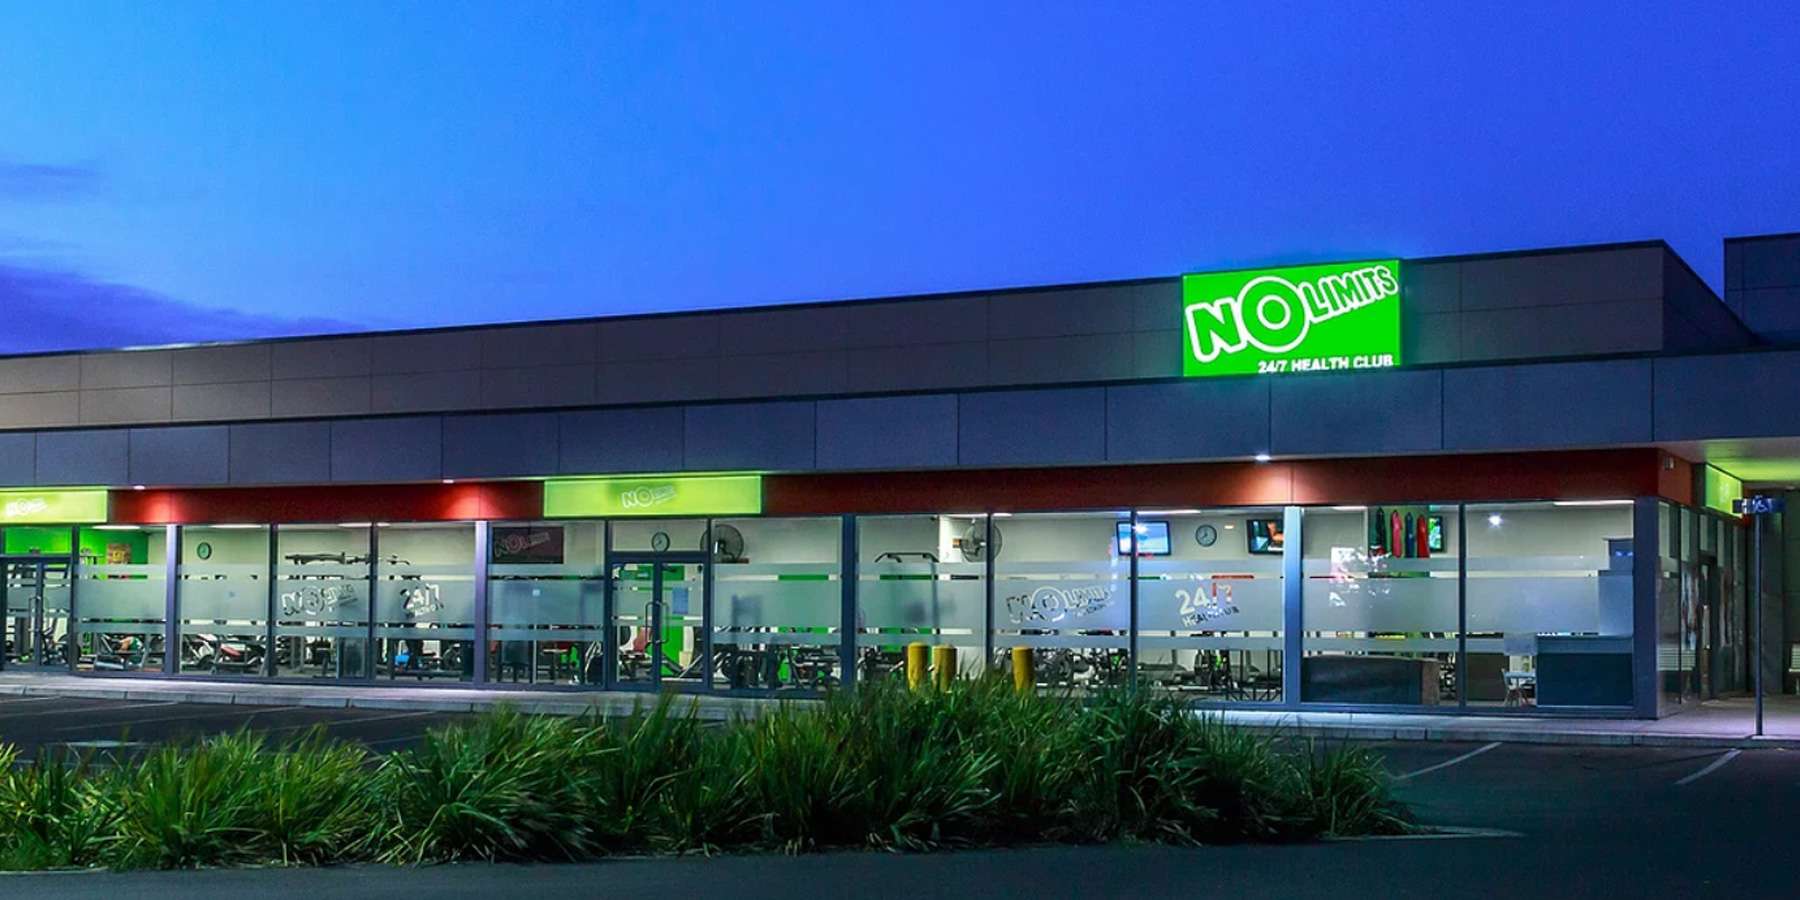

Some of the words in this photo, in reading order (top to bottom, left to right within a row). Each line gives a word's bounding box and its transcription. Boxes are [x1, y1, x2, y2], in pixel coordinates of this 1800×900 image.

[1185, 276, 1310, 363] NO
[1299, 266, 1399, 323] LIMITS
[1257, 360, 1287, 374] 24/7
[1291, 356, 1348, 372] HEALTH
[1353, 354, 1394, 369] CLUB
[621, 486, 654, 509] NO
